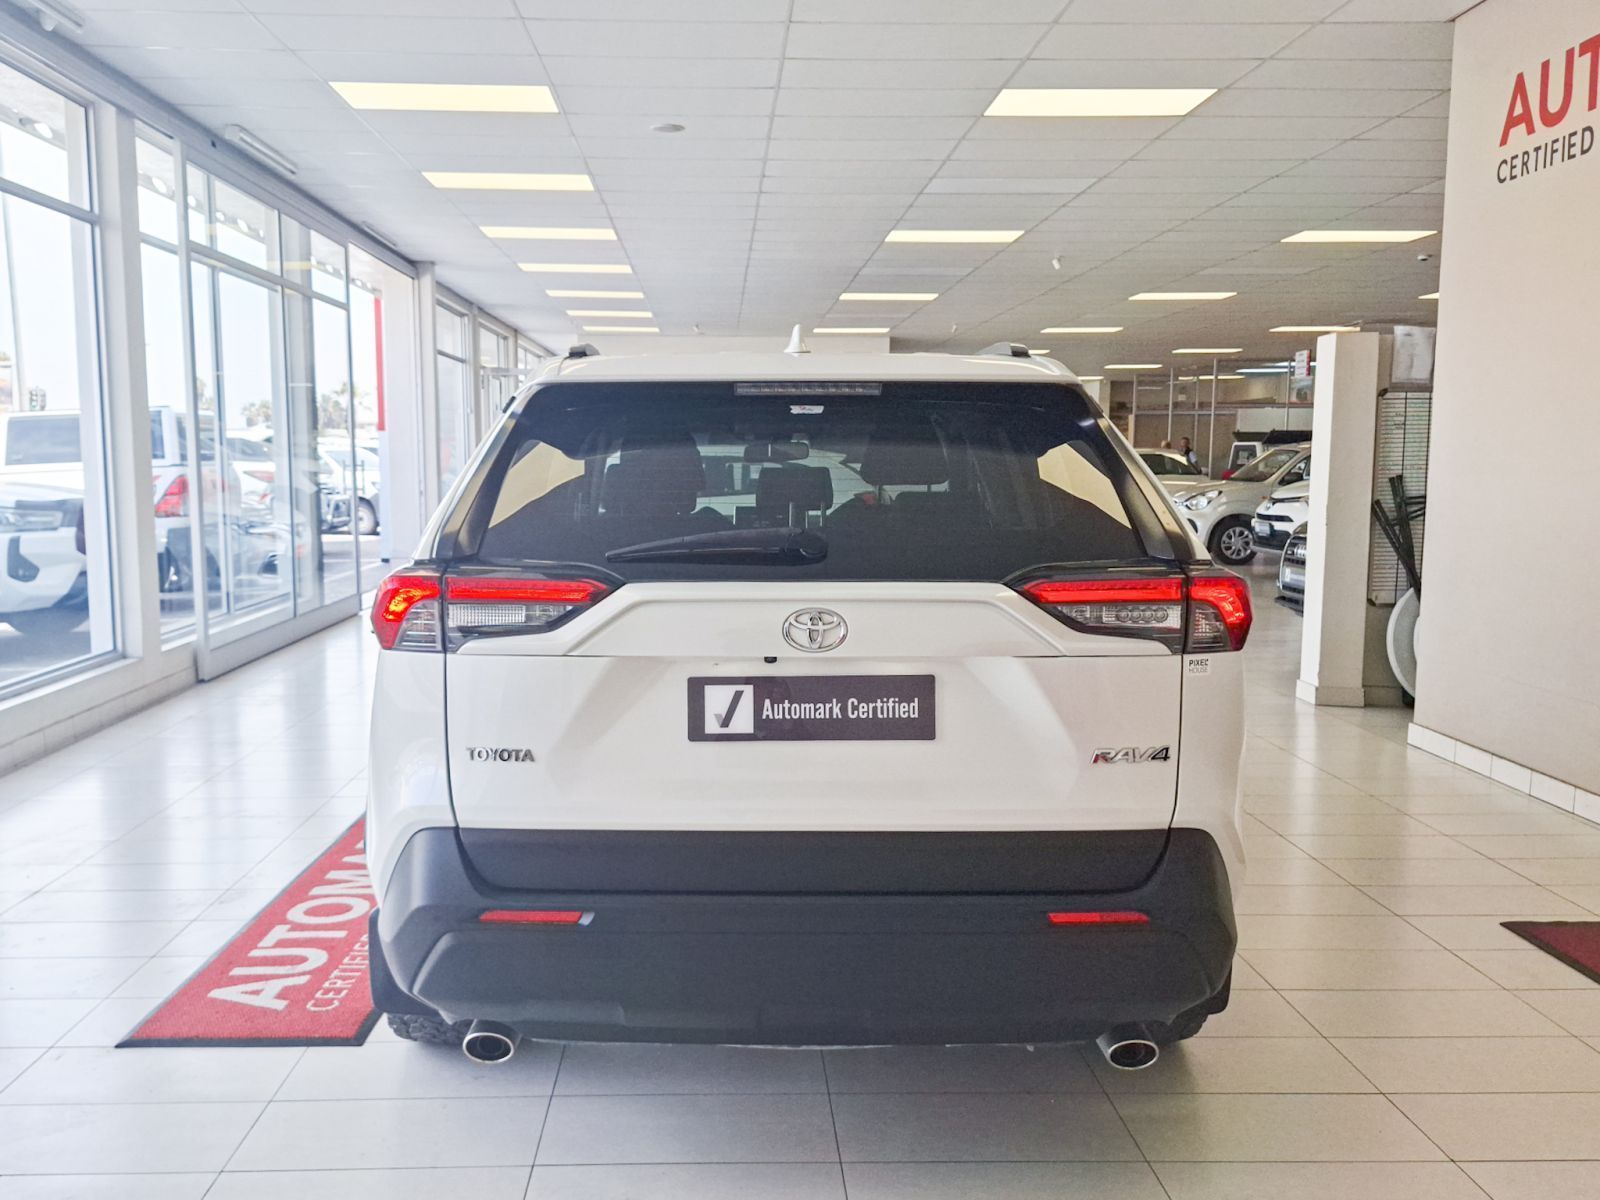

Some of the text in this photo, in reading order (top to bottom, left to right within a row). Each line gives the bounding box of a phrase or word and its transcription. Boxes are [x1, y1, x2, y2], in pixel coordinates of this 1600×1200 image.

[1499, 33, 1600, 147] AUT
[1497, 125, 1595, 184] CERTIFIED
[762, 697, 919, 720] Automark Certified
[466, 747, 536, 762] TOYOTA
[1091, 745, 1171, 764] RAV4
[207, 840, 374, 1012] AUTOM
